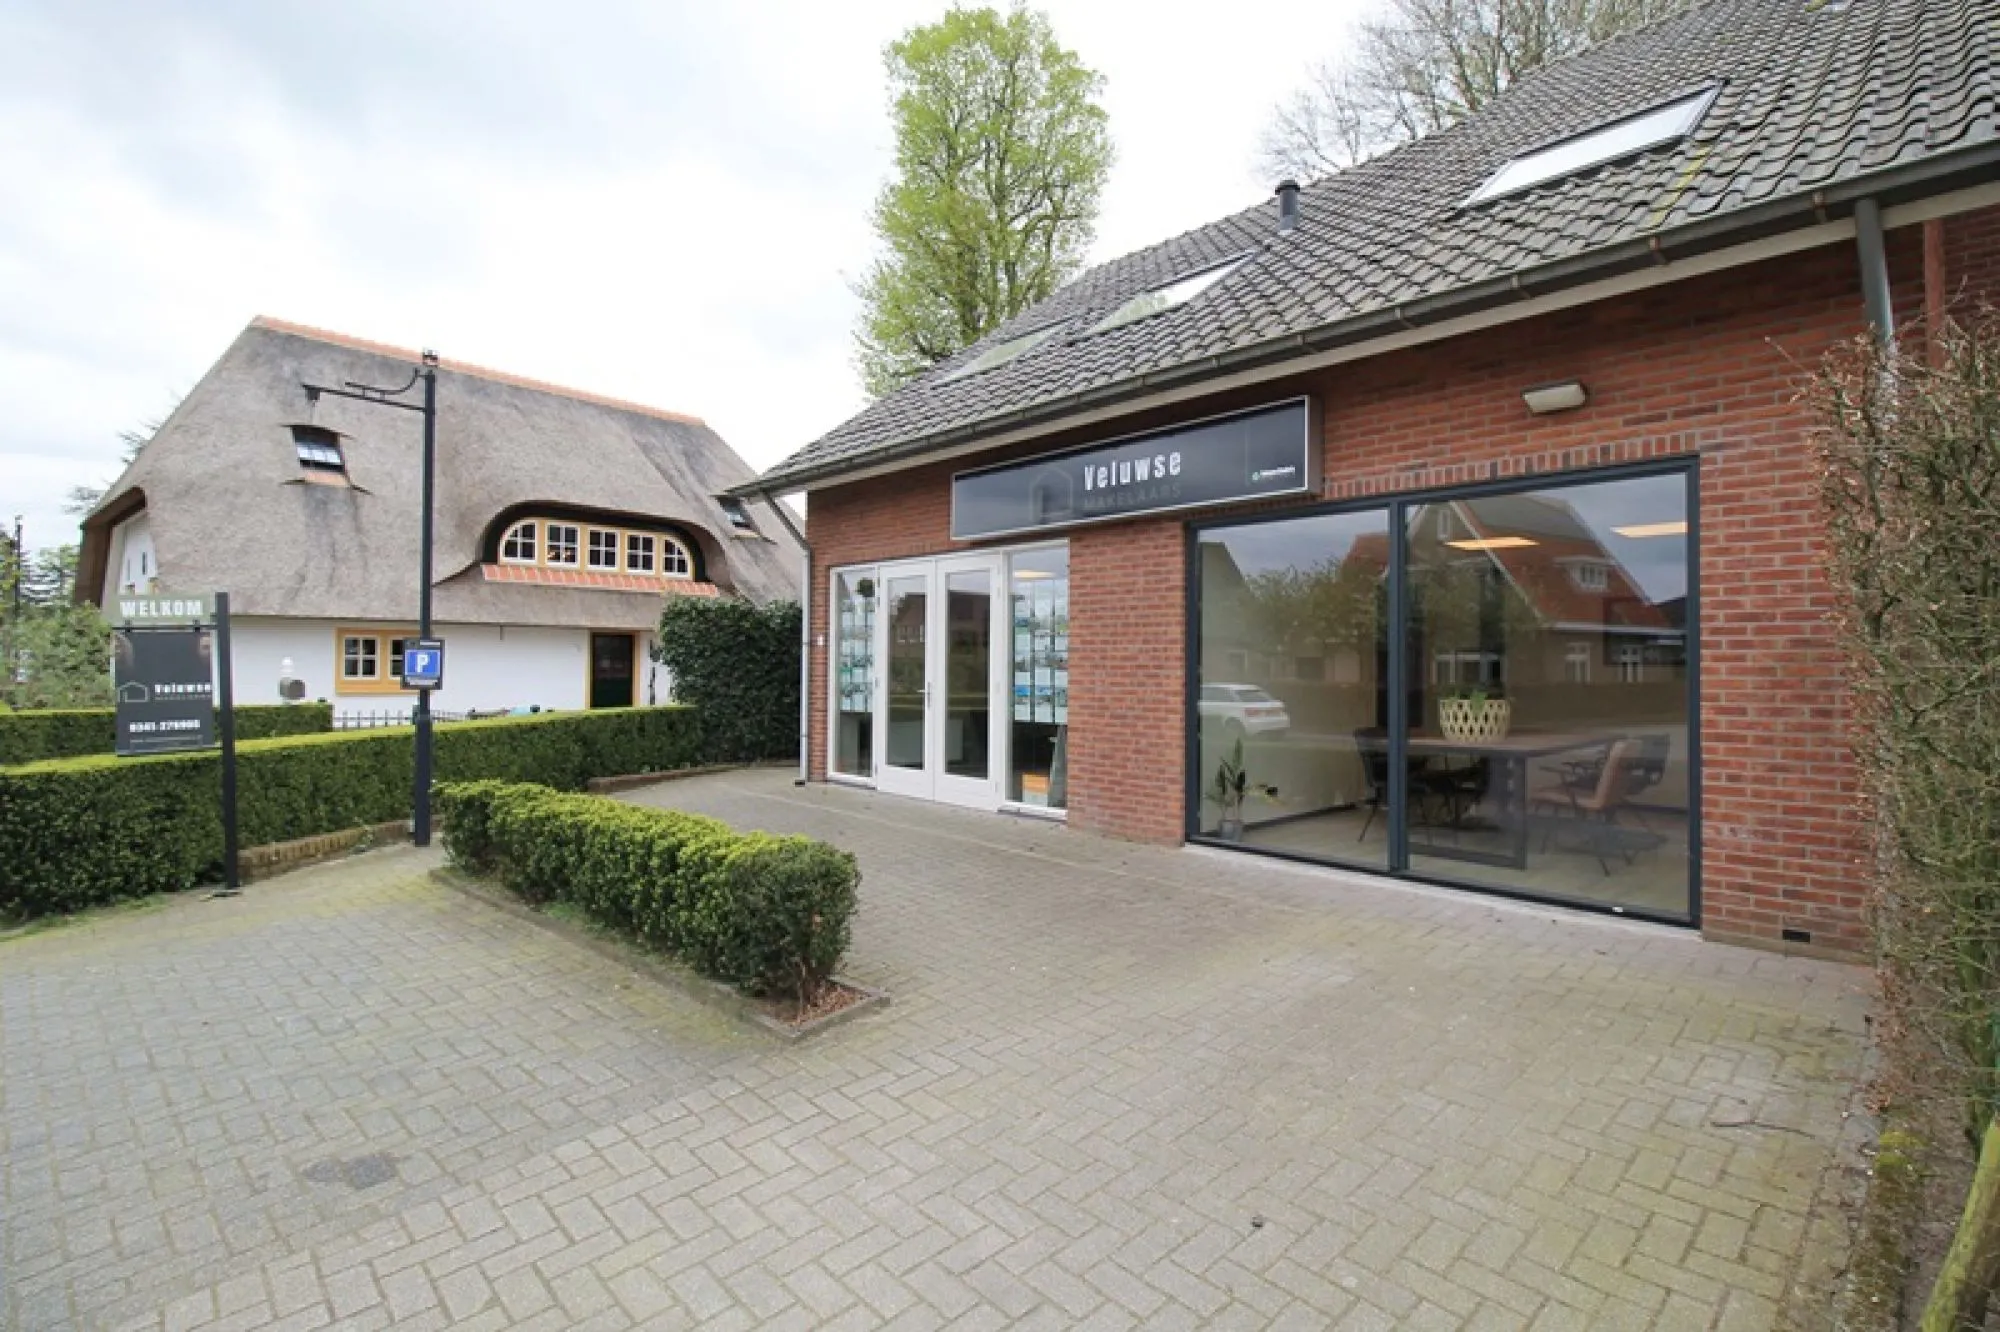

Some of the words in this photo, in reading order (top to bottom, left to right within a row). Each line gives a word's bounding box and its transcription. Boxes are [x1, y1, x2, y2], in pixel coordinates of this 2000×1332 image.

[1084, 452, 1181, 491] Veluwse
[119, 600, 203, 617] WELKOM
[417, 654, 429, 673] P
